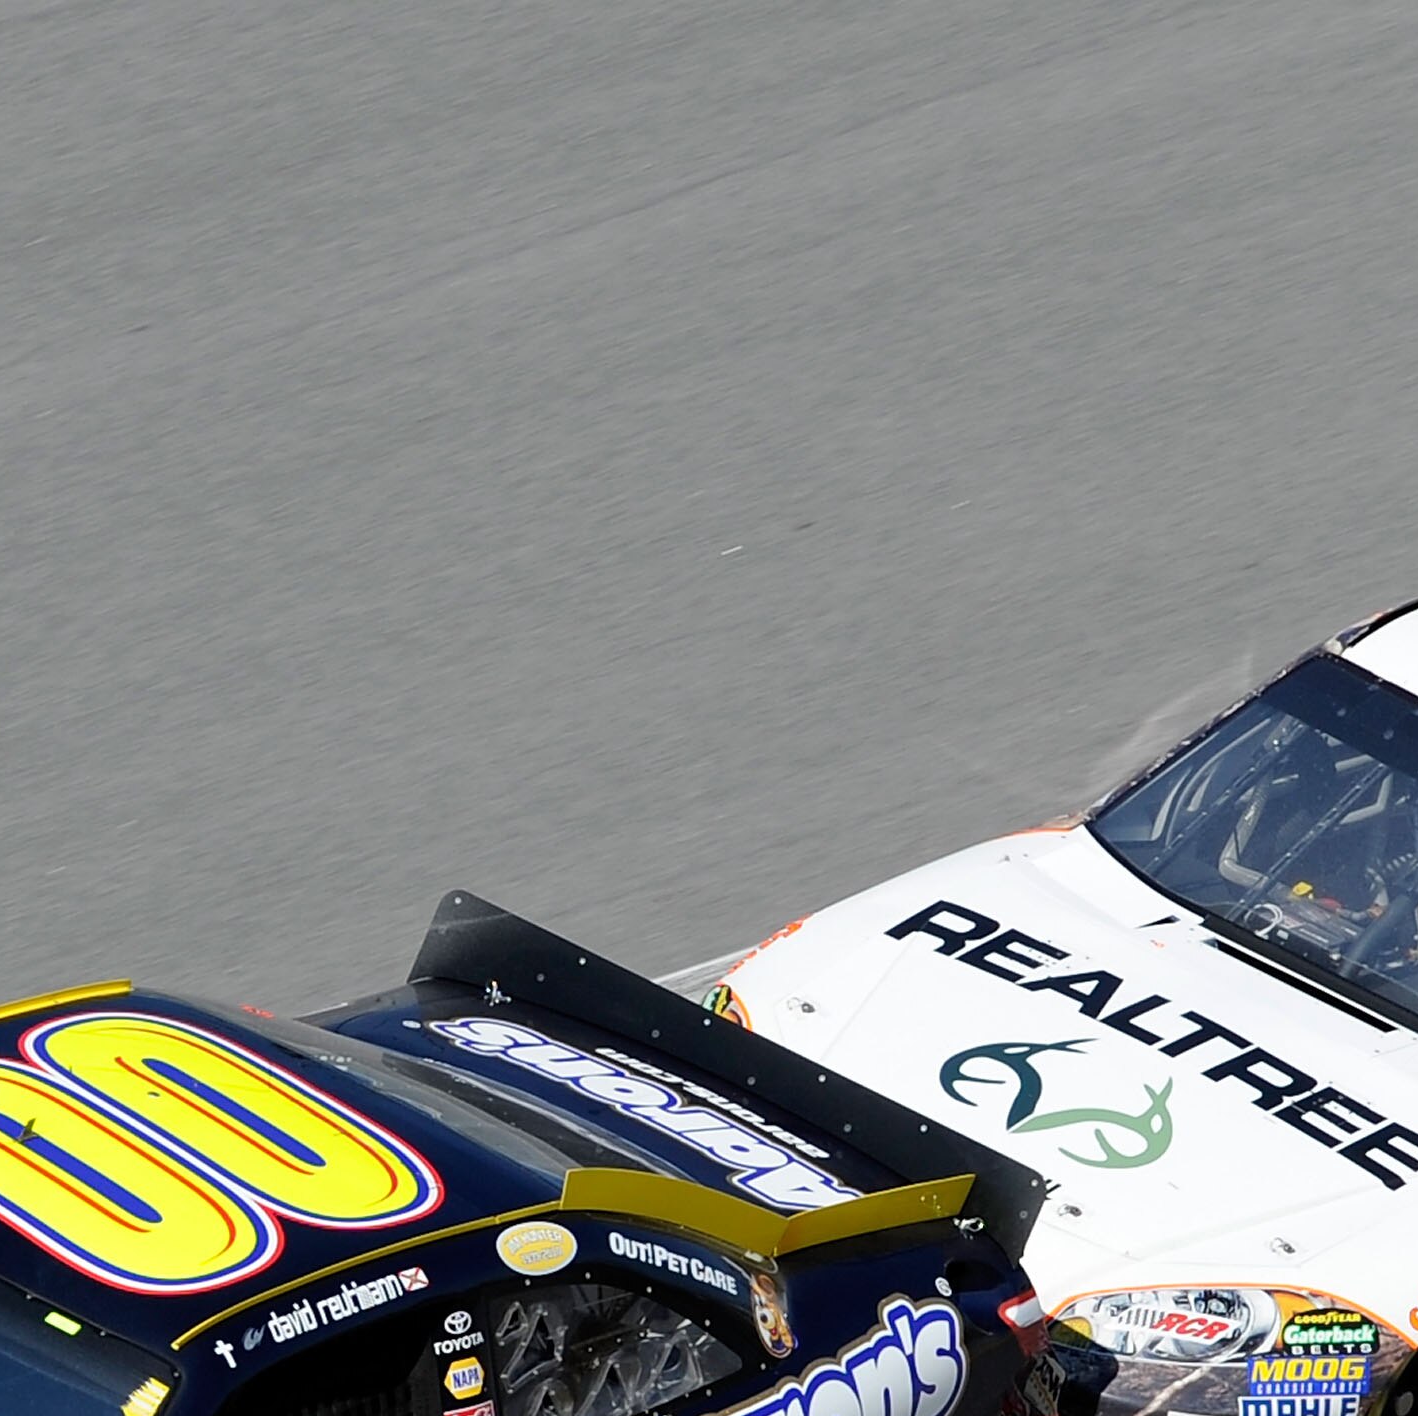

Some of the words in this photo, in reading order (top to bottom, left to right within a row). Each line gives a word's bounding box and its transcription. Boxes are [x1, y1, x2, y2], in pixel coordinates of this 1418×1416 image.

[267, 1298, 319, 1344] david
[1152, 1312, 1230, 1340] RCR
[1294, 1311, 1362, 1325] GOODYEAR
[433, 1331, 485, 1356] TOYOTA
[1283, 1324, 1376, 1345] Gatorback
[1291, 1345, 1374, 1355] BELTS
[452, 1367, 481, 1390] NAPA
[1251, 1357, 1367, 1383] MOOG
[1256, 1382, 1314, 1395] CHASSIS
[1321, 1381, 1363, 1393] PARTS
